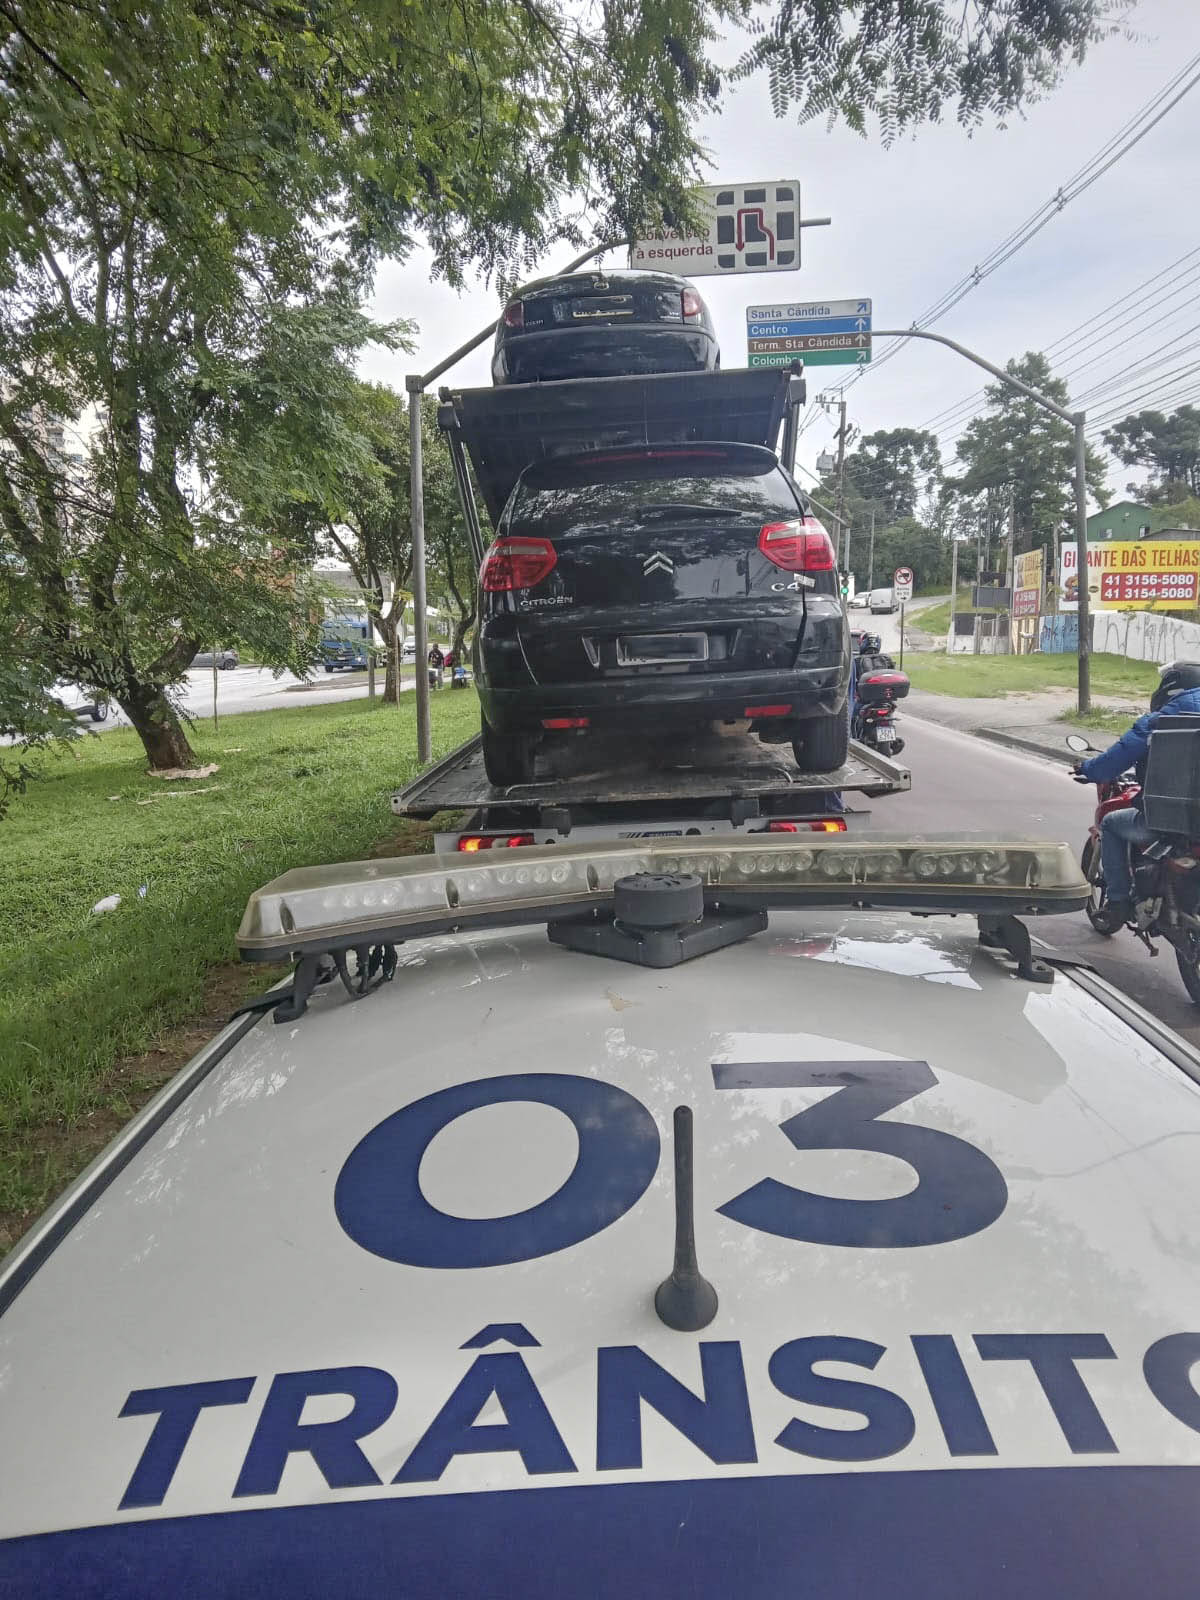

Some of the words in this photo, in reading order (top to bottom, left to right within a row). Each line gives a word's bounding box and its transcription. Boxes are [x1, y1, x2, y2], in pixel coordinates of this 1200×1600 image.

[637, 248, 645, 259] à
[648, 244, 713, 260] esquerda
[751, 309, 782, 319] Santa
[787, 306, 831, 317] Cândida
[751, 325, 788, 335] Centro
[785, 339, 804, 349] Sta
[808, 336, 852, 347] Cândida
[1064, 550, 1118, 568] GIANTE
[1121, 550, 1147, 567] DAS
[1152, 549, 1200, 566] TELHAS
[1105, 575, 1120, 585] 41
[1125, 574, 1194, 585] 3156-5080
[771, 582, 800, 591] C4
[1104, 588, 1120, 598] 41
[1124, 587, 1193, 598] 3154-5080
[334, 1060, 1008, 1269] 03
